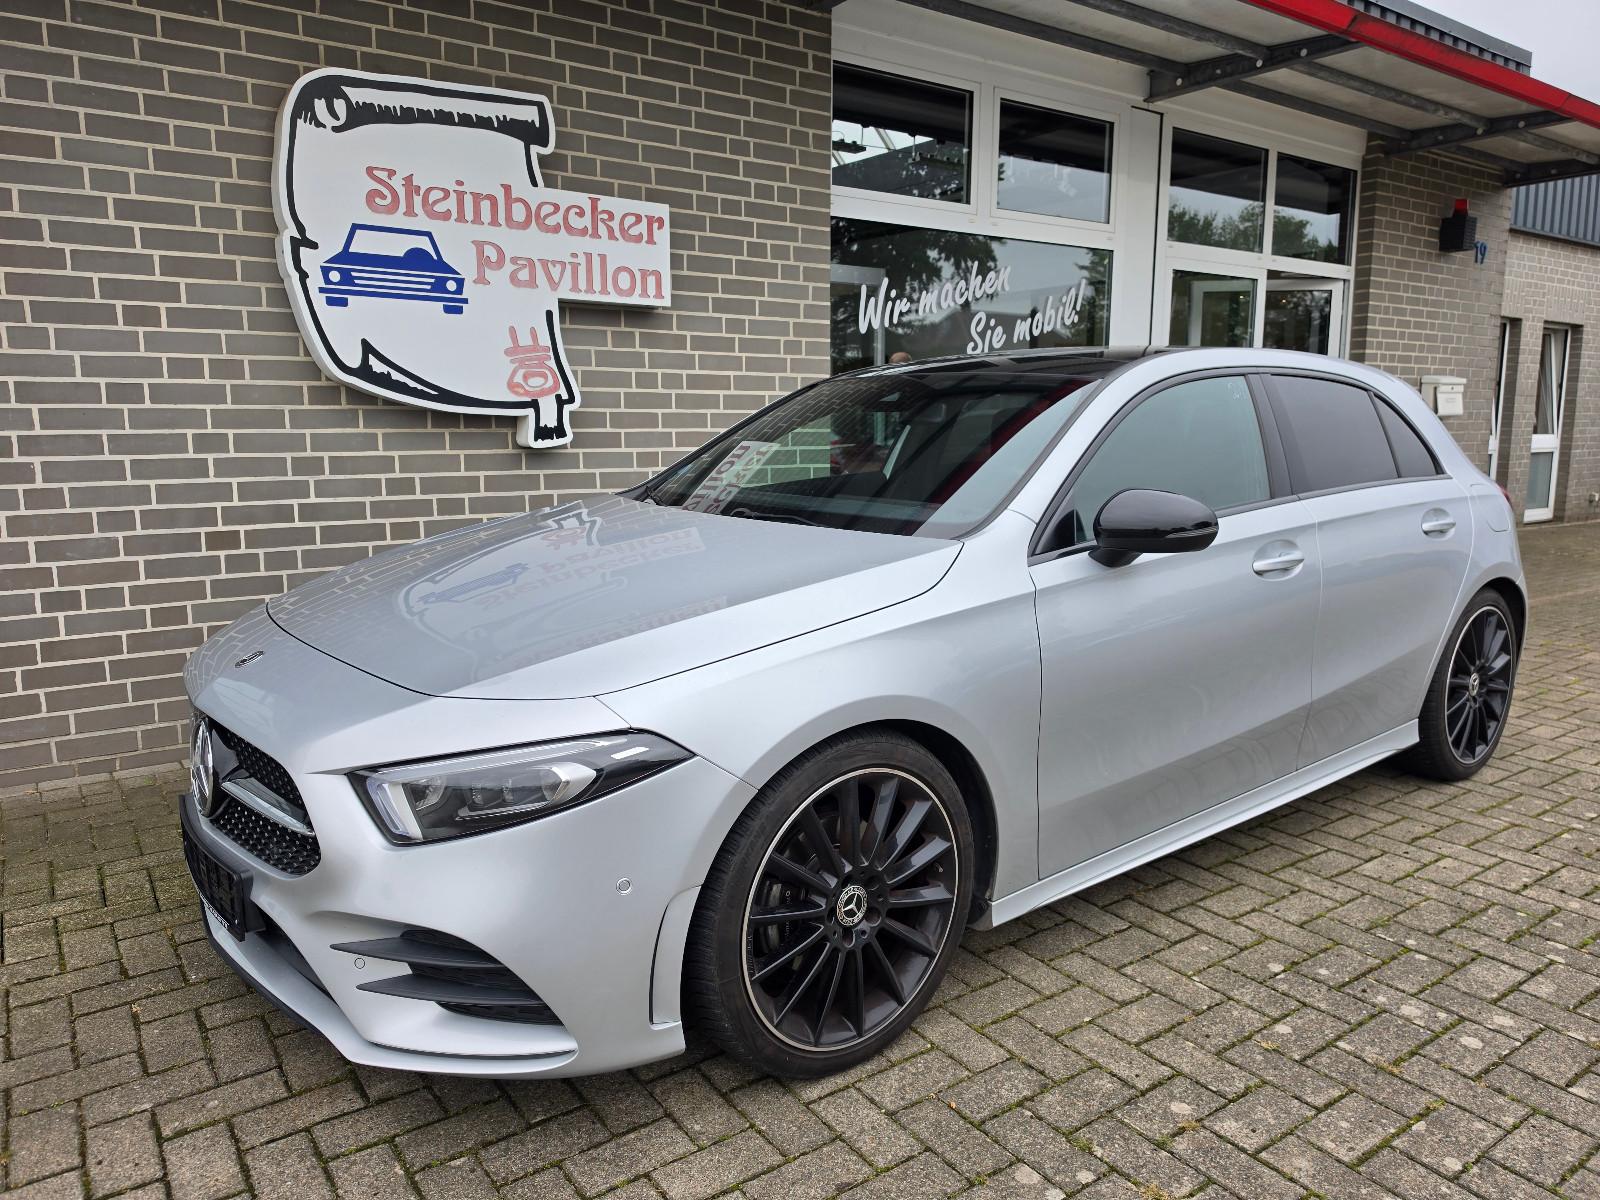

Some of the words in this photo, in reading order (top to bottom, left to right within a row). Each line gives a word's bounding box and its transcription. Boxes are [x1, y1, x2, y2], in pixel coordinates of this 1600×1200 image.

[365, 165, 664, 246] Steinbecker
[471, 239, 665, 300] Pavillon
[858, 277, 911, 335] Wir
[918, 260, 1012, 316] machen
[966, 311, 1007, 355] Sie
[1013, 278, 1087, 344] mobil!
